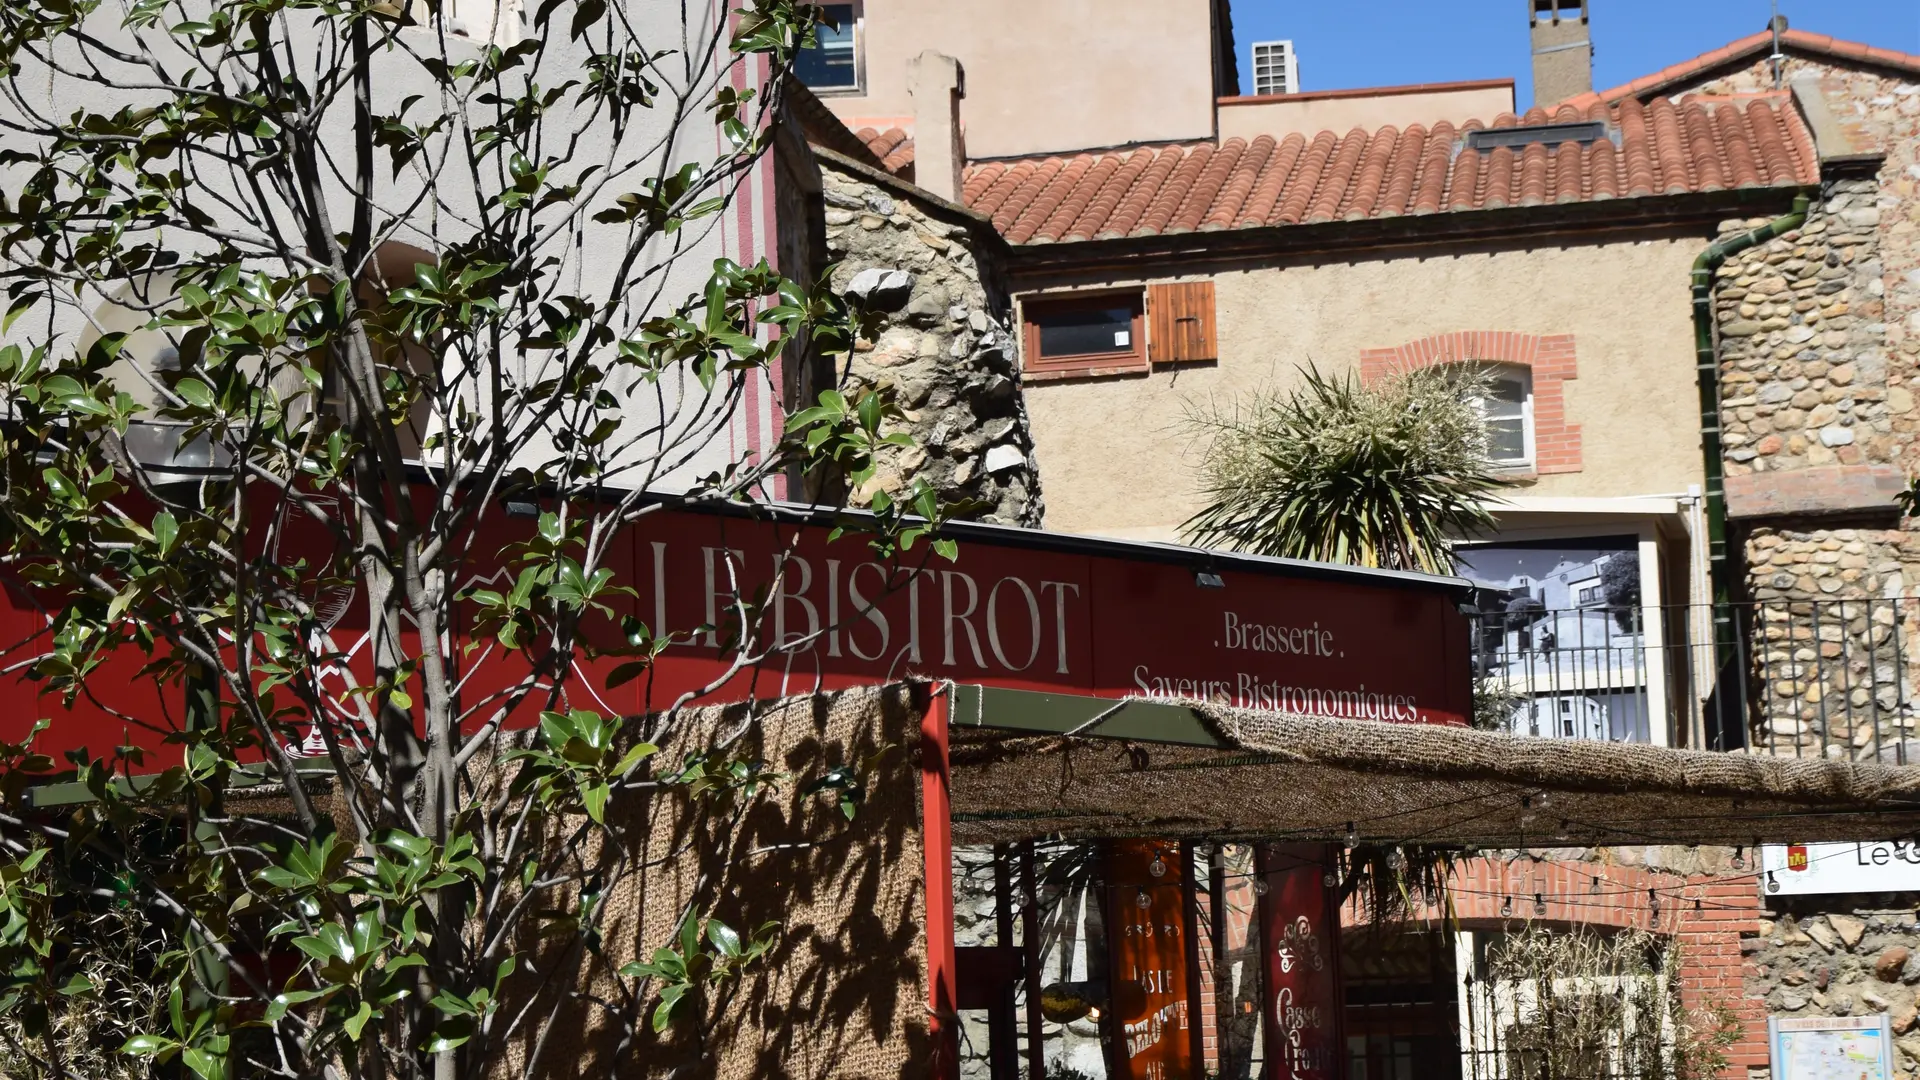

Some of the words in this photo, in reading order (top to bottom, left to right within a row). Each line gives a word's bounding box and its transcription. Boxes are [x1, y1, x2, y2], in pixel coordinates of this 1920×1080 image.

[650, 541, 746, 650] LE
[772, 553, 1080, 675] BISTROT
[1134, 664, 1232, 706] Saveurs
[1237, 672, 1417, 722] Bistronomiques
